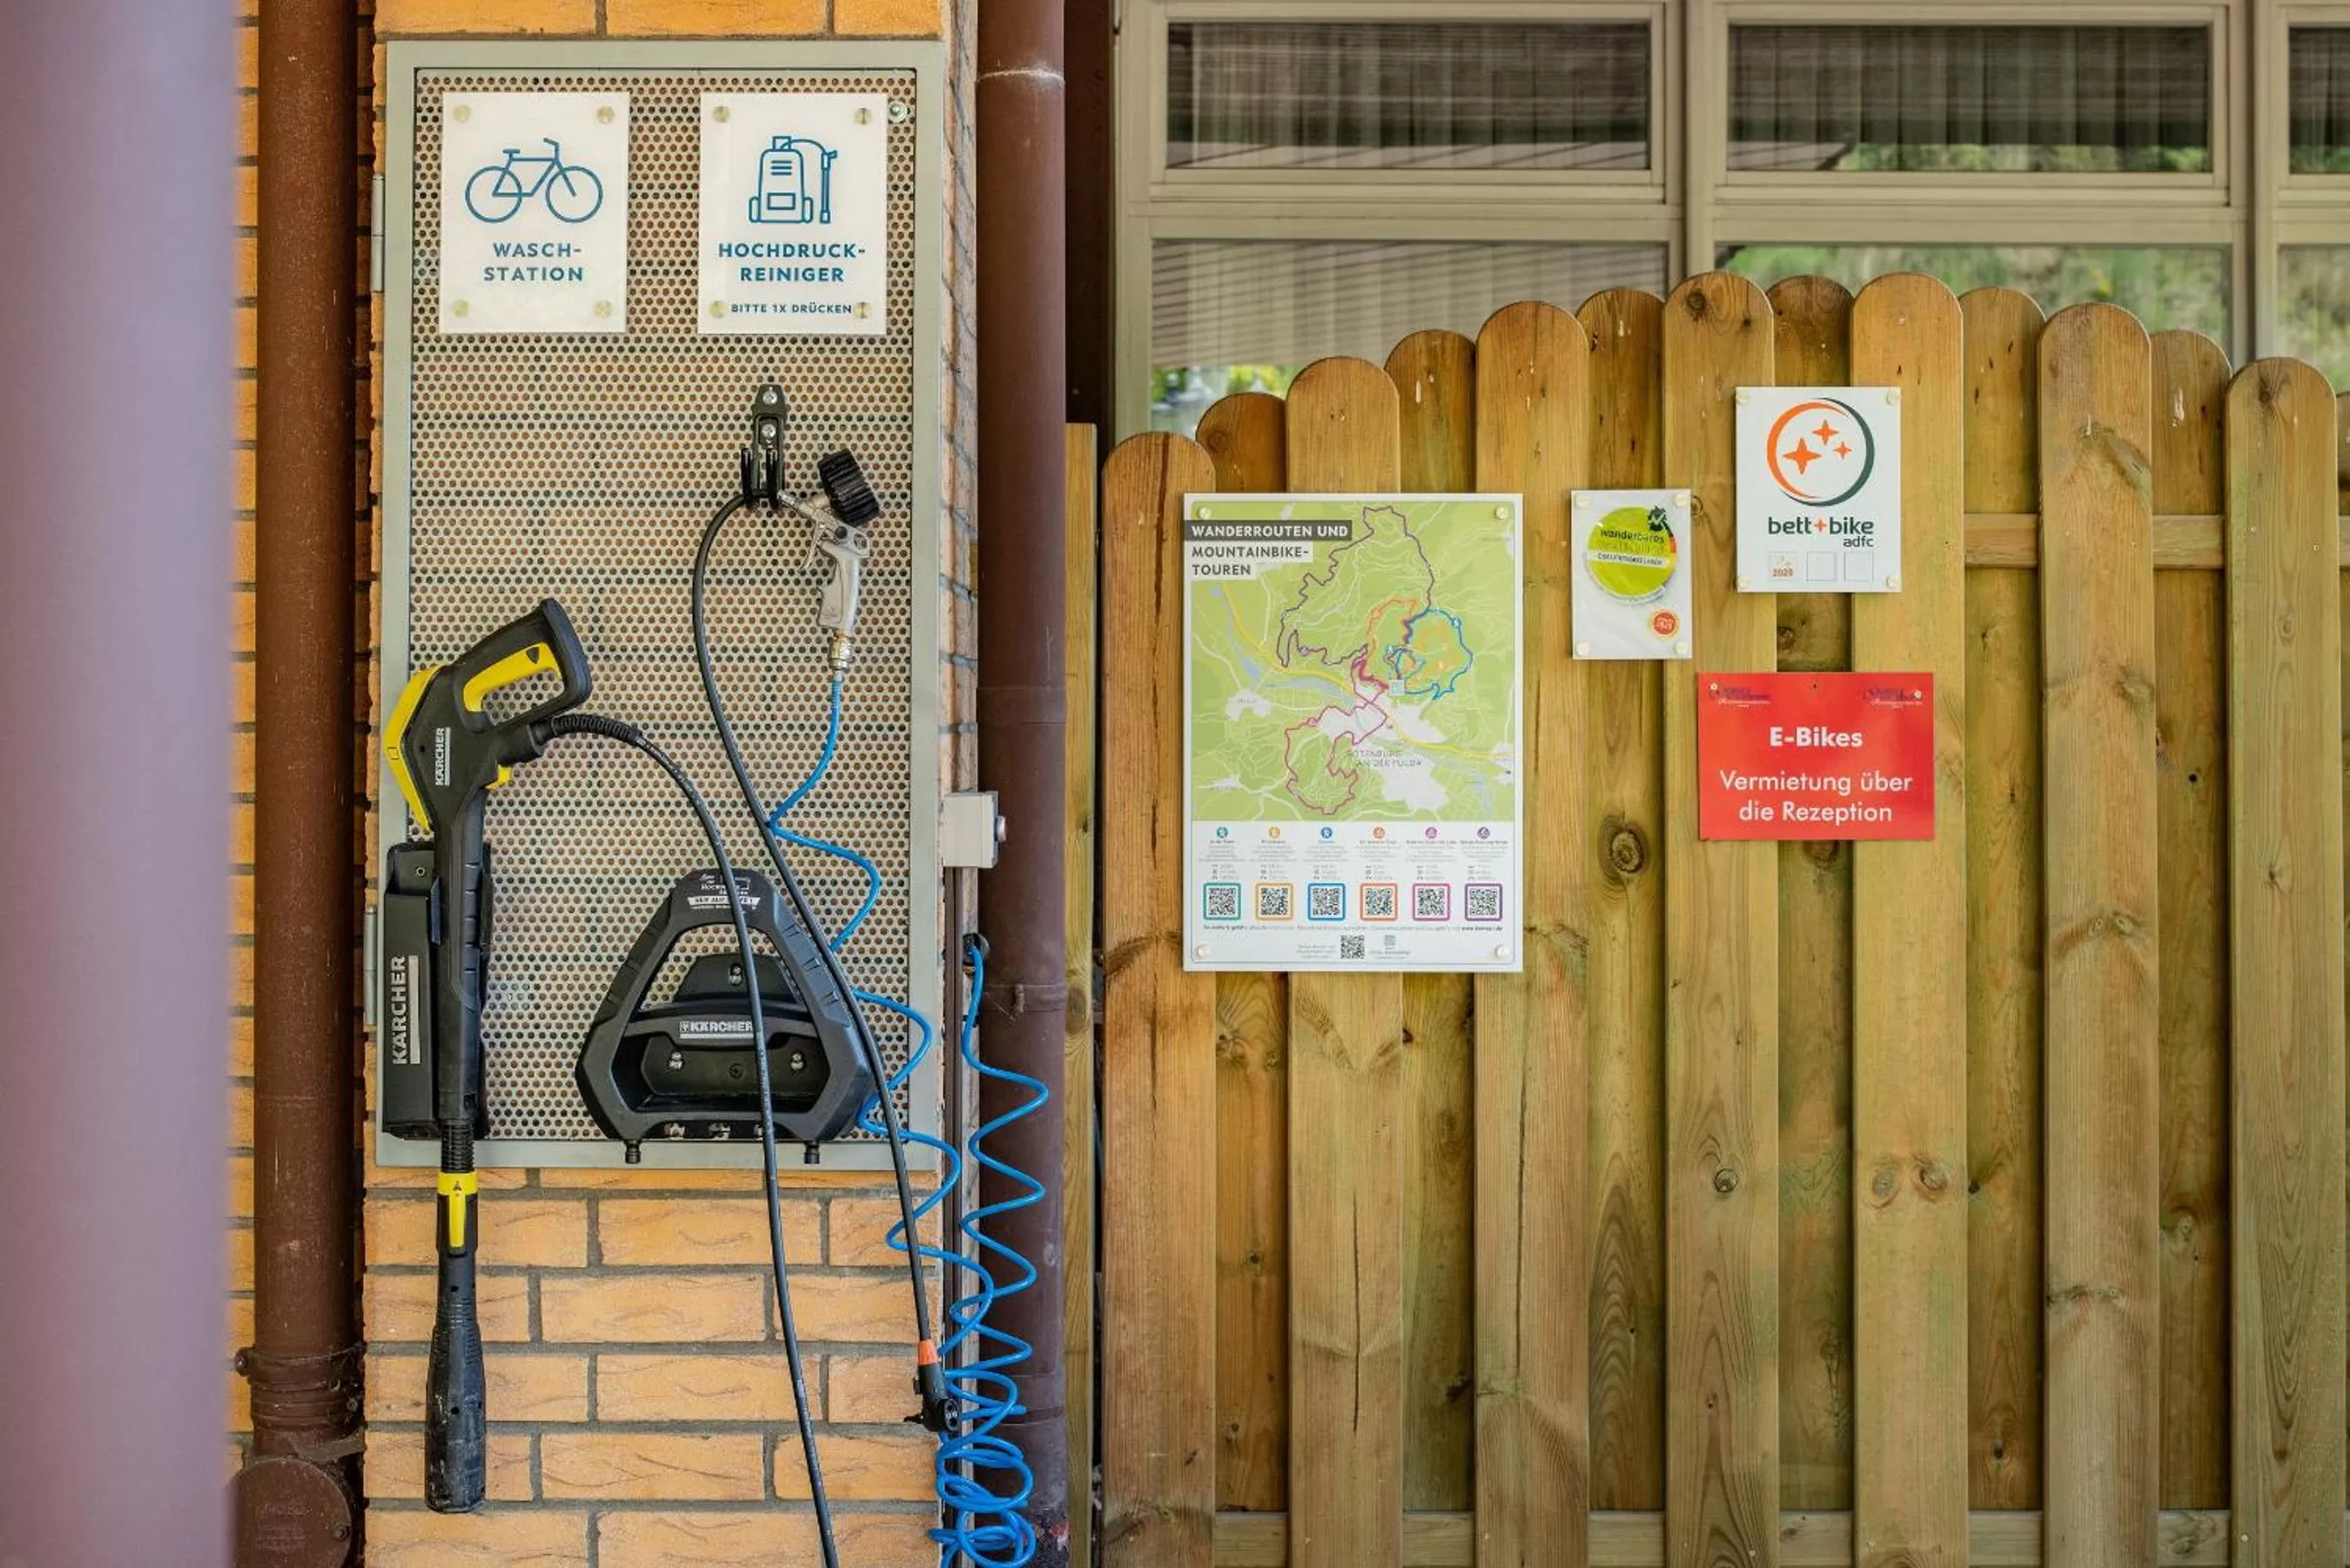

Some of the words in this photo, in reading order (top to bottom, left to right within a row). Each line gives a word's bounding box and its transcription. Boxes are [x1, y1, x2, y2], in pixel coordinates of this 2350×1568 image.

[493, 242, 582, 258] WASCH-
[718, 243, 866, 258] HOCHDRUCK-
[484, 266, 583, 282] STATION
[740, 267, 844, 282] REINIGER
[731, 304, 767, 313] BITTE
[773, 304, 787, 313] 1X
[792, 302, 852, 314] DRÜCKEN
[1192, 525, 1313, 537] WANDERROUTEN
[1318, 525, 1348, 537] UND
[1843, 535, 1874, 547] adfc
[1192, 546, 1309, 558] MOUNTAINBIKE-
[1192, 564, 1252, 575] TOUREN
[1769, 726, 1863, 747] E-Bikes
[435, 727, 445, 786] KÄRCHER
[1720, 770, 1851, 796] Vermietung
[1861, 771, 1913, 792] über
[1739, 799, 1775, 821] die
[1783, 801, 1892, 826] Rezeption
[390, 956, 407, 1064] KÄRCHER
